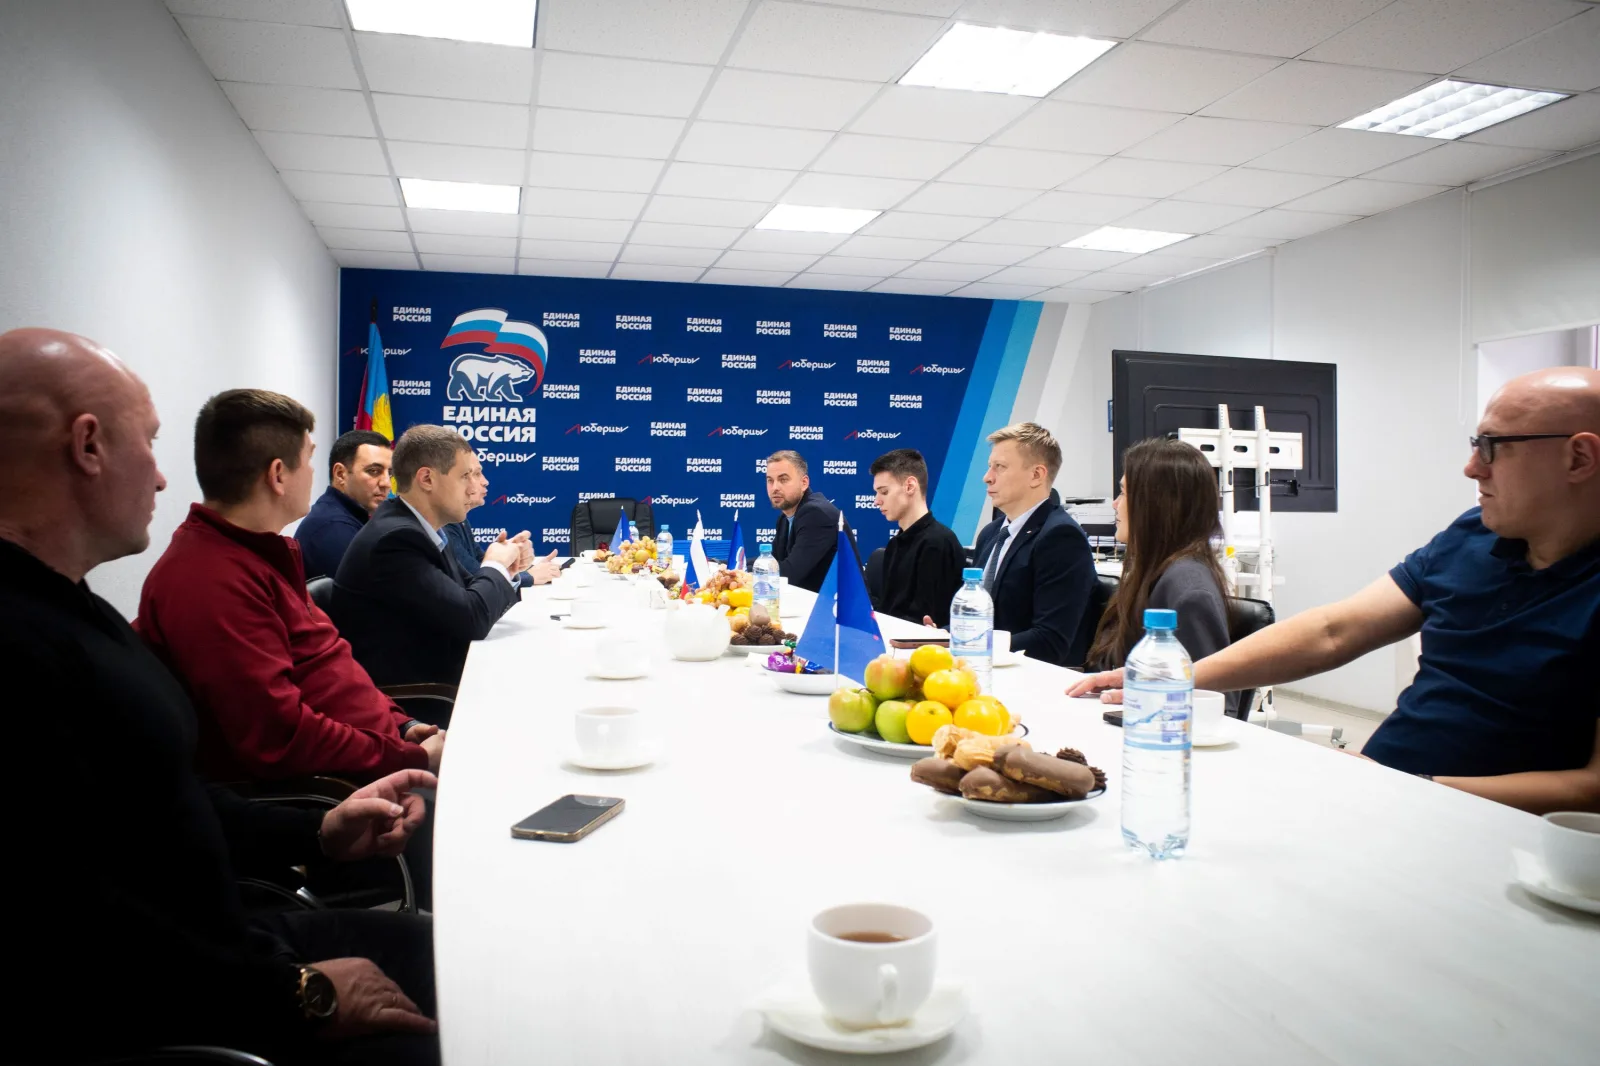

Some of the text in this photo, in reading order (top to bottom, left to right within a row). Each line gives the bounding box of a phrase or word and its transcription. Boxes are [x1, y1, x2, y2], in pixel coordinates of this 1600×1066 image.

[393, 307, 431, 315] ЕДИНАЯ
[393, 314, 431, 322] РОССИЯ
[543, 313, 580, 321] ЕДИНАЯ
[615, 315, 652, 323] ЕДИНАЯ
[687, 317, 722, 325] ЕДИНАЯ
[543, 320, 580, 328] РОССИЯ
[615, 322, 652, 330] РОССИЯ
[687, 324, 722, 332] РОССИЯ
[756, 321, 790, 329] ЕДИНАЯ
[824, 323, 857, 331] ЕДИНАЯ
[756, 328, 790, 336] РОССИЯ
[824, 330, 857, 338] РОССИЯ
[579, 349, 616, 357] ЕДИНАЯ
[579, 356, 616, 364] РОССИЯ
[638, 354, 700, 367] Люберцы
[721, 354, 757, 362] ЕДИНАЯ
[721, 361, 757, 369] РОССИЯ
[778, 359, 837, 371] Люберцы
[910, 364, 965, 376] Люберцы
[393, 380, 431, 388] ЕДИНАЯ
[543, 384, 580, 392] ЕДИНАЯ
[393, 387, 431, 395] РОССИЯ
[615, 386, 652, 394] ЕДИНАЯ
[687, 387, 722, 395] ЕДИНАЯ
[543, 391, 580, 399] РОССИЯ
[615, 393, 652, 401] РОССИЯ
[687, 395, 722, 403] РОССИЯ
[443, 406, 536, 423] ЕДИНАЯ
[565, 423, 629, 436] Люберцы
[650, 422, 686, 430] ЕДИНАЯ
[650, 429, 686, 437] РОССИЯ
[708, 426, 769, 439] Люберцы
[844, 429, 901, 441] Люберцы
[476, 447, 537, 467] берцы
[542, 457, 580, 465] ЕДИНАЯ
[615, 457, 652, 465] ЕДИНАЯ
[542, 464, 580, 472] РОССИЯ
[615, 464, 652, 472] РОССИЯ
[492, 494, 556, 506] Люберцы
[579, 492, 616, 500] ЕДИНАЯ
